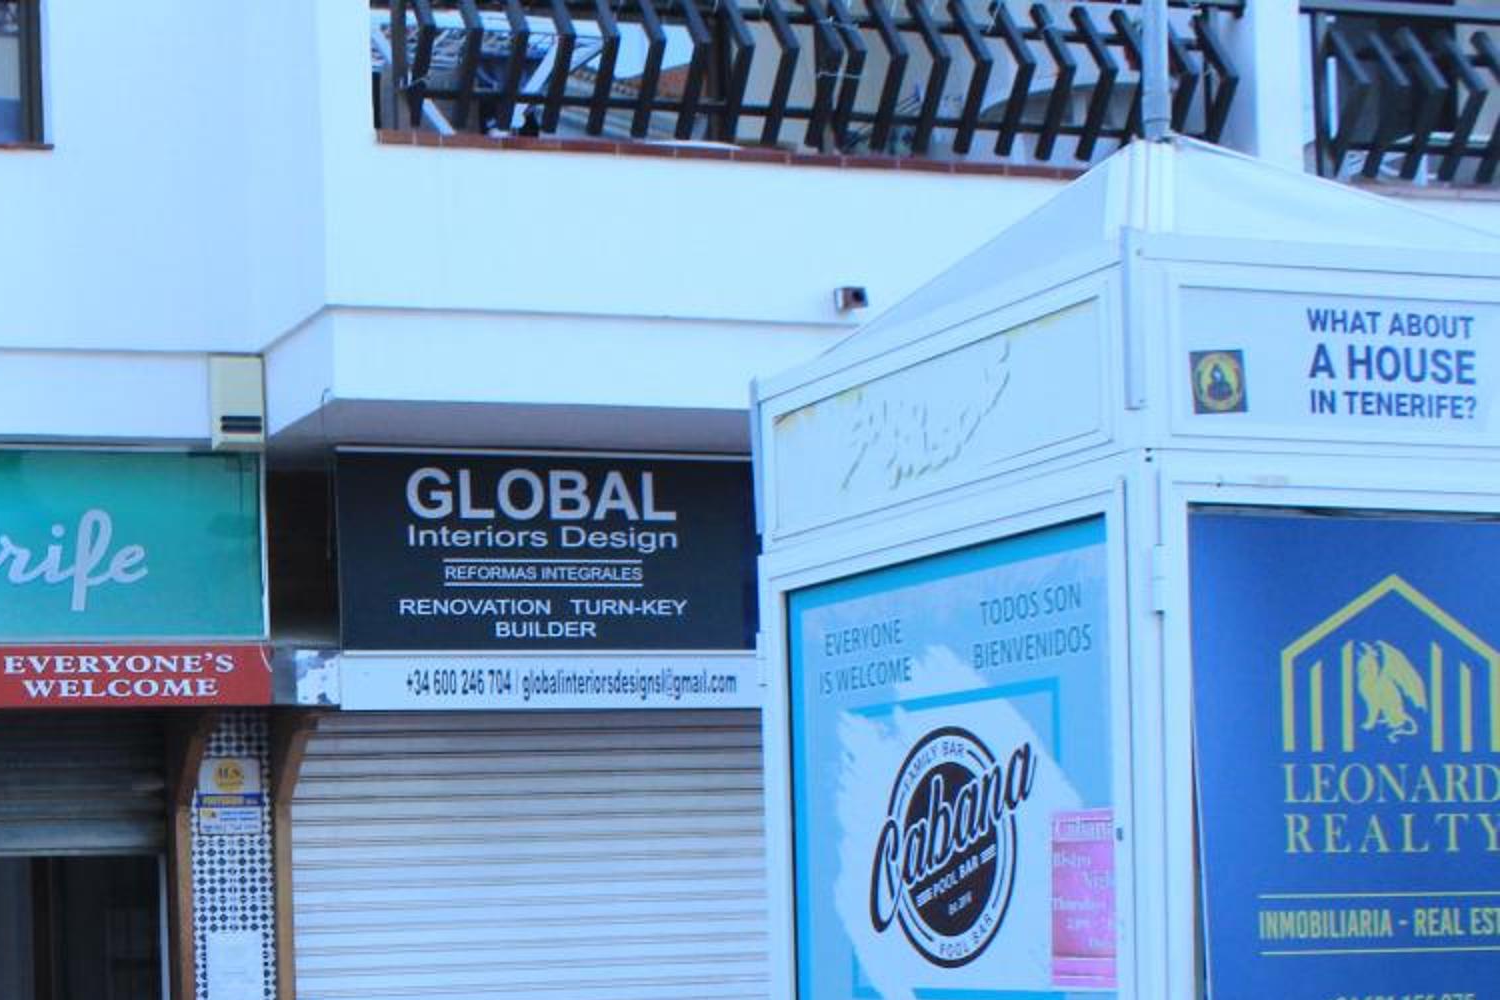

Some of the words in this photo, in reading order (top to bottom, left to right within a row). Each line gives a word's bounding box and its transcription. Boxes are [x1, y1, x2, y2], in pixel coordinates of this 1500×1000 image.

[1307, 307, 1382, 336] WHAT
[1389, 311, 1475, 339] ABOUT
[1308, 343, 1337, 380] A
[1348, 345, 1477, 385] HOUSE
[1310, 389, 1336, 414] IN
[1343, 390, 1478, 419] TENERIFE?
[406, 466, 678, 522] GLOBAL
[407, 524, 549, 549] Interiors
[561, 525, 679, 554] Design
[445, 565, 537, 582] REFORMAS
[541, 566, 644, 583] INTEGRALES
[400, 598, 552, 616] RENOVATION
[570, 598, 689, 616] TURN-KEY
[980, 590, 1040, 626] TODOS
[1044, 584, 1083, 615] SON
[495, 621, 598, 638] BUILDER
[824, 619, 903, 657] EVERYONE
[974, 623, 1093, 670] BIENVENIDOS
[3, 652, 236, 676] EVERYONE'S
[819, 671, 833, 695] IS
[835, 656, 913, 692] WELCOME
[22, 678, 221, 699] WELCOME
[406, 669, 430, 695] +34
[433, 669, 457, 695] 600
[461, 669, 485, 695] 246
[488, 669, 512, 695] 704
[1283, 762, 1500, 805] LEONARD
[870, 741, 1037, 934] Cabana
[1284, 812, 1500, 854] REALTY
[1258, 908, 1393, 940] INMOBILIARIA
[1414, 907, 1466, 937] REAL
